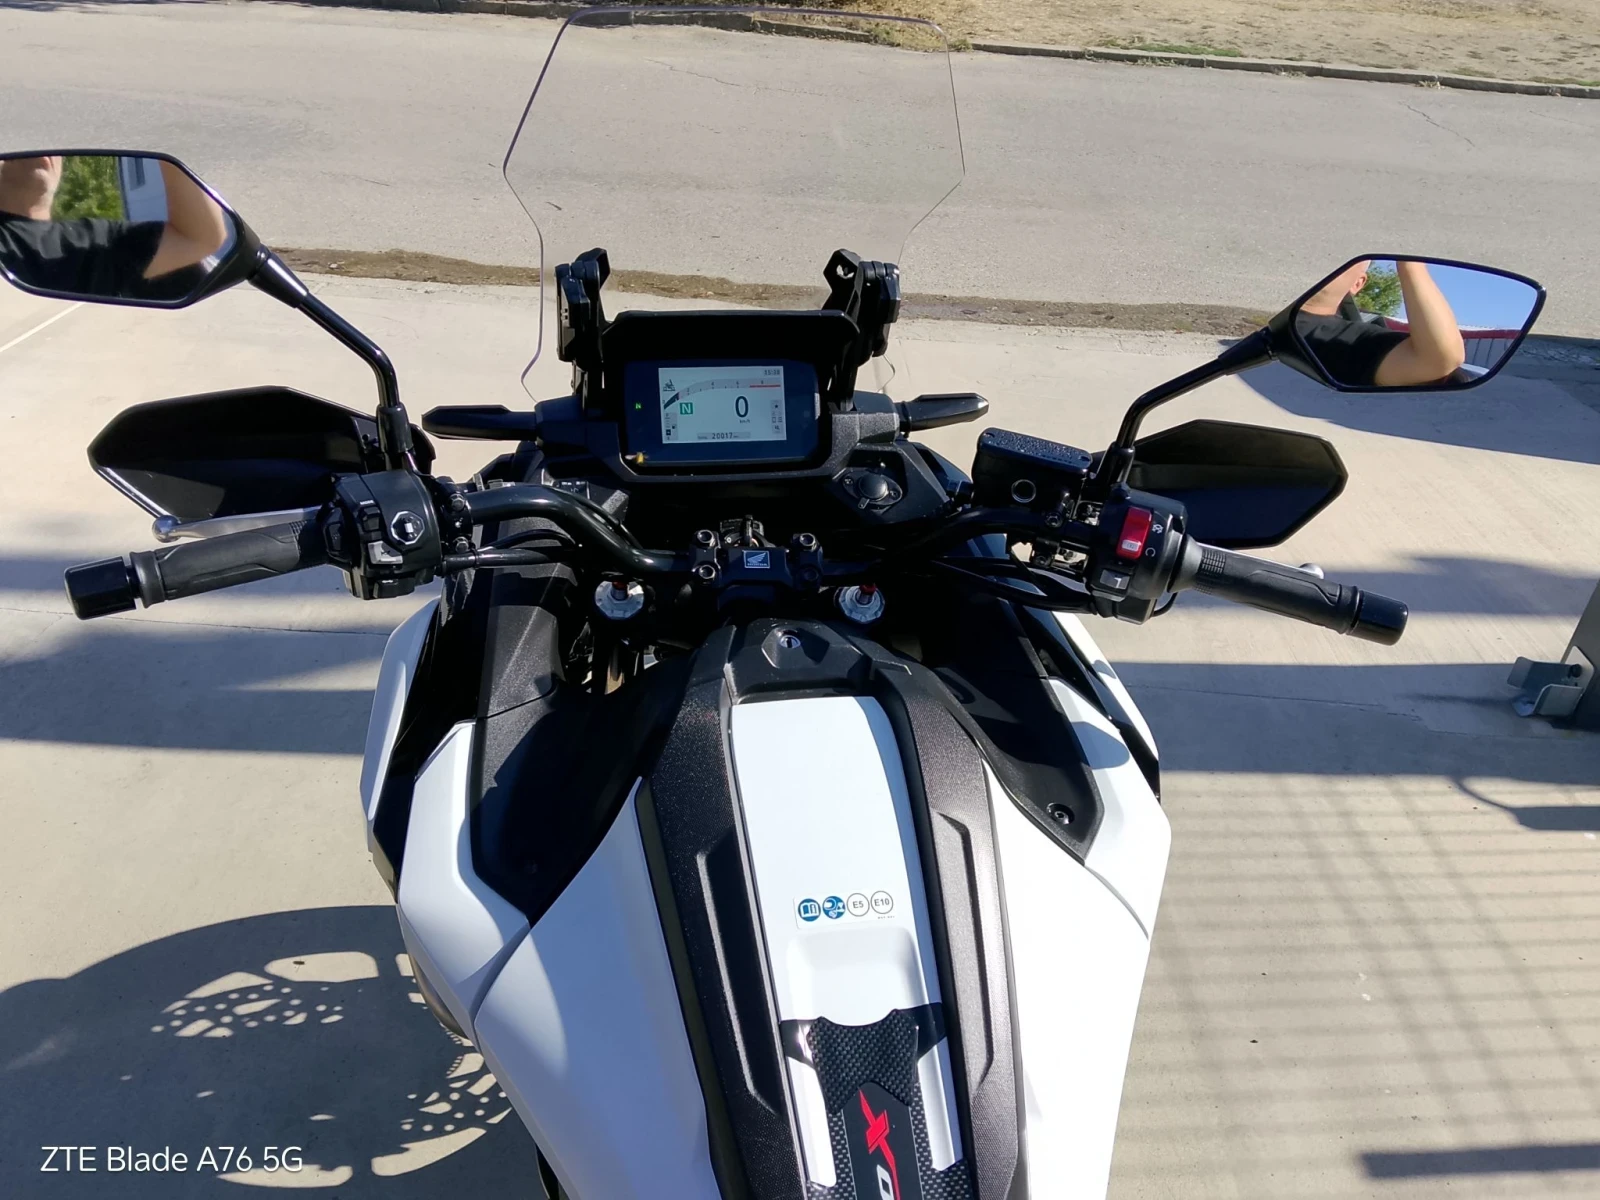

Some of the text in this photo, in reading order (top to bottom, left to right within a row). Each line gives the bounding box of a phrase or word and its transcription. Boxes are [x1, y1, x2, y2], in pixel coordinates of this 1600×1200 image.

[681, 403, 692, 414] N
[735, 396, 749, 418] 0
[711, 432, 733, 440] 20017
[852, 898, 890, 909] E5 E10
